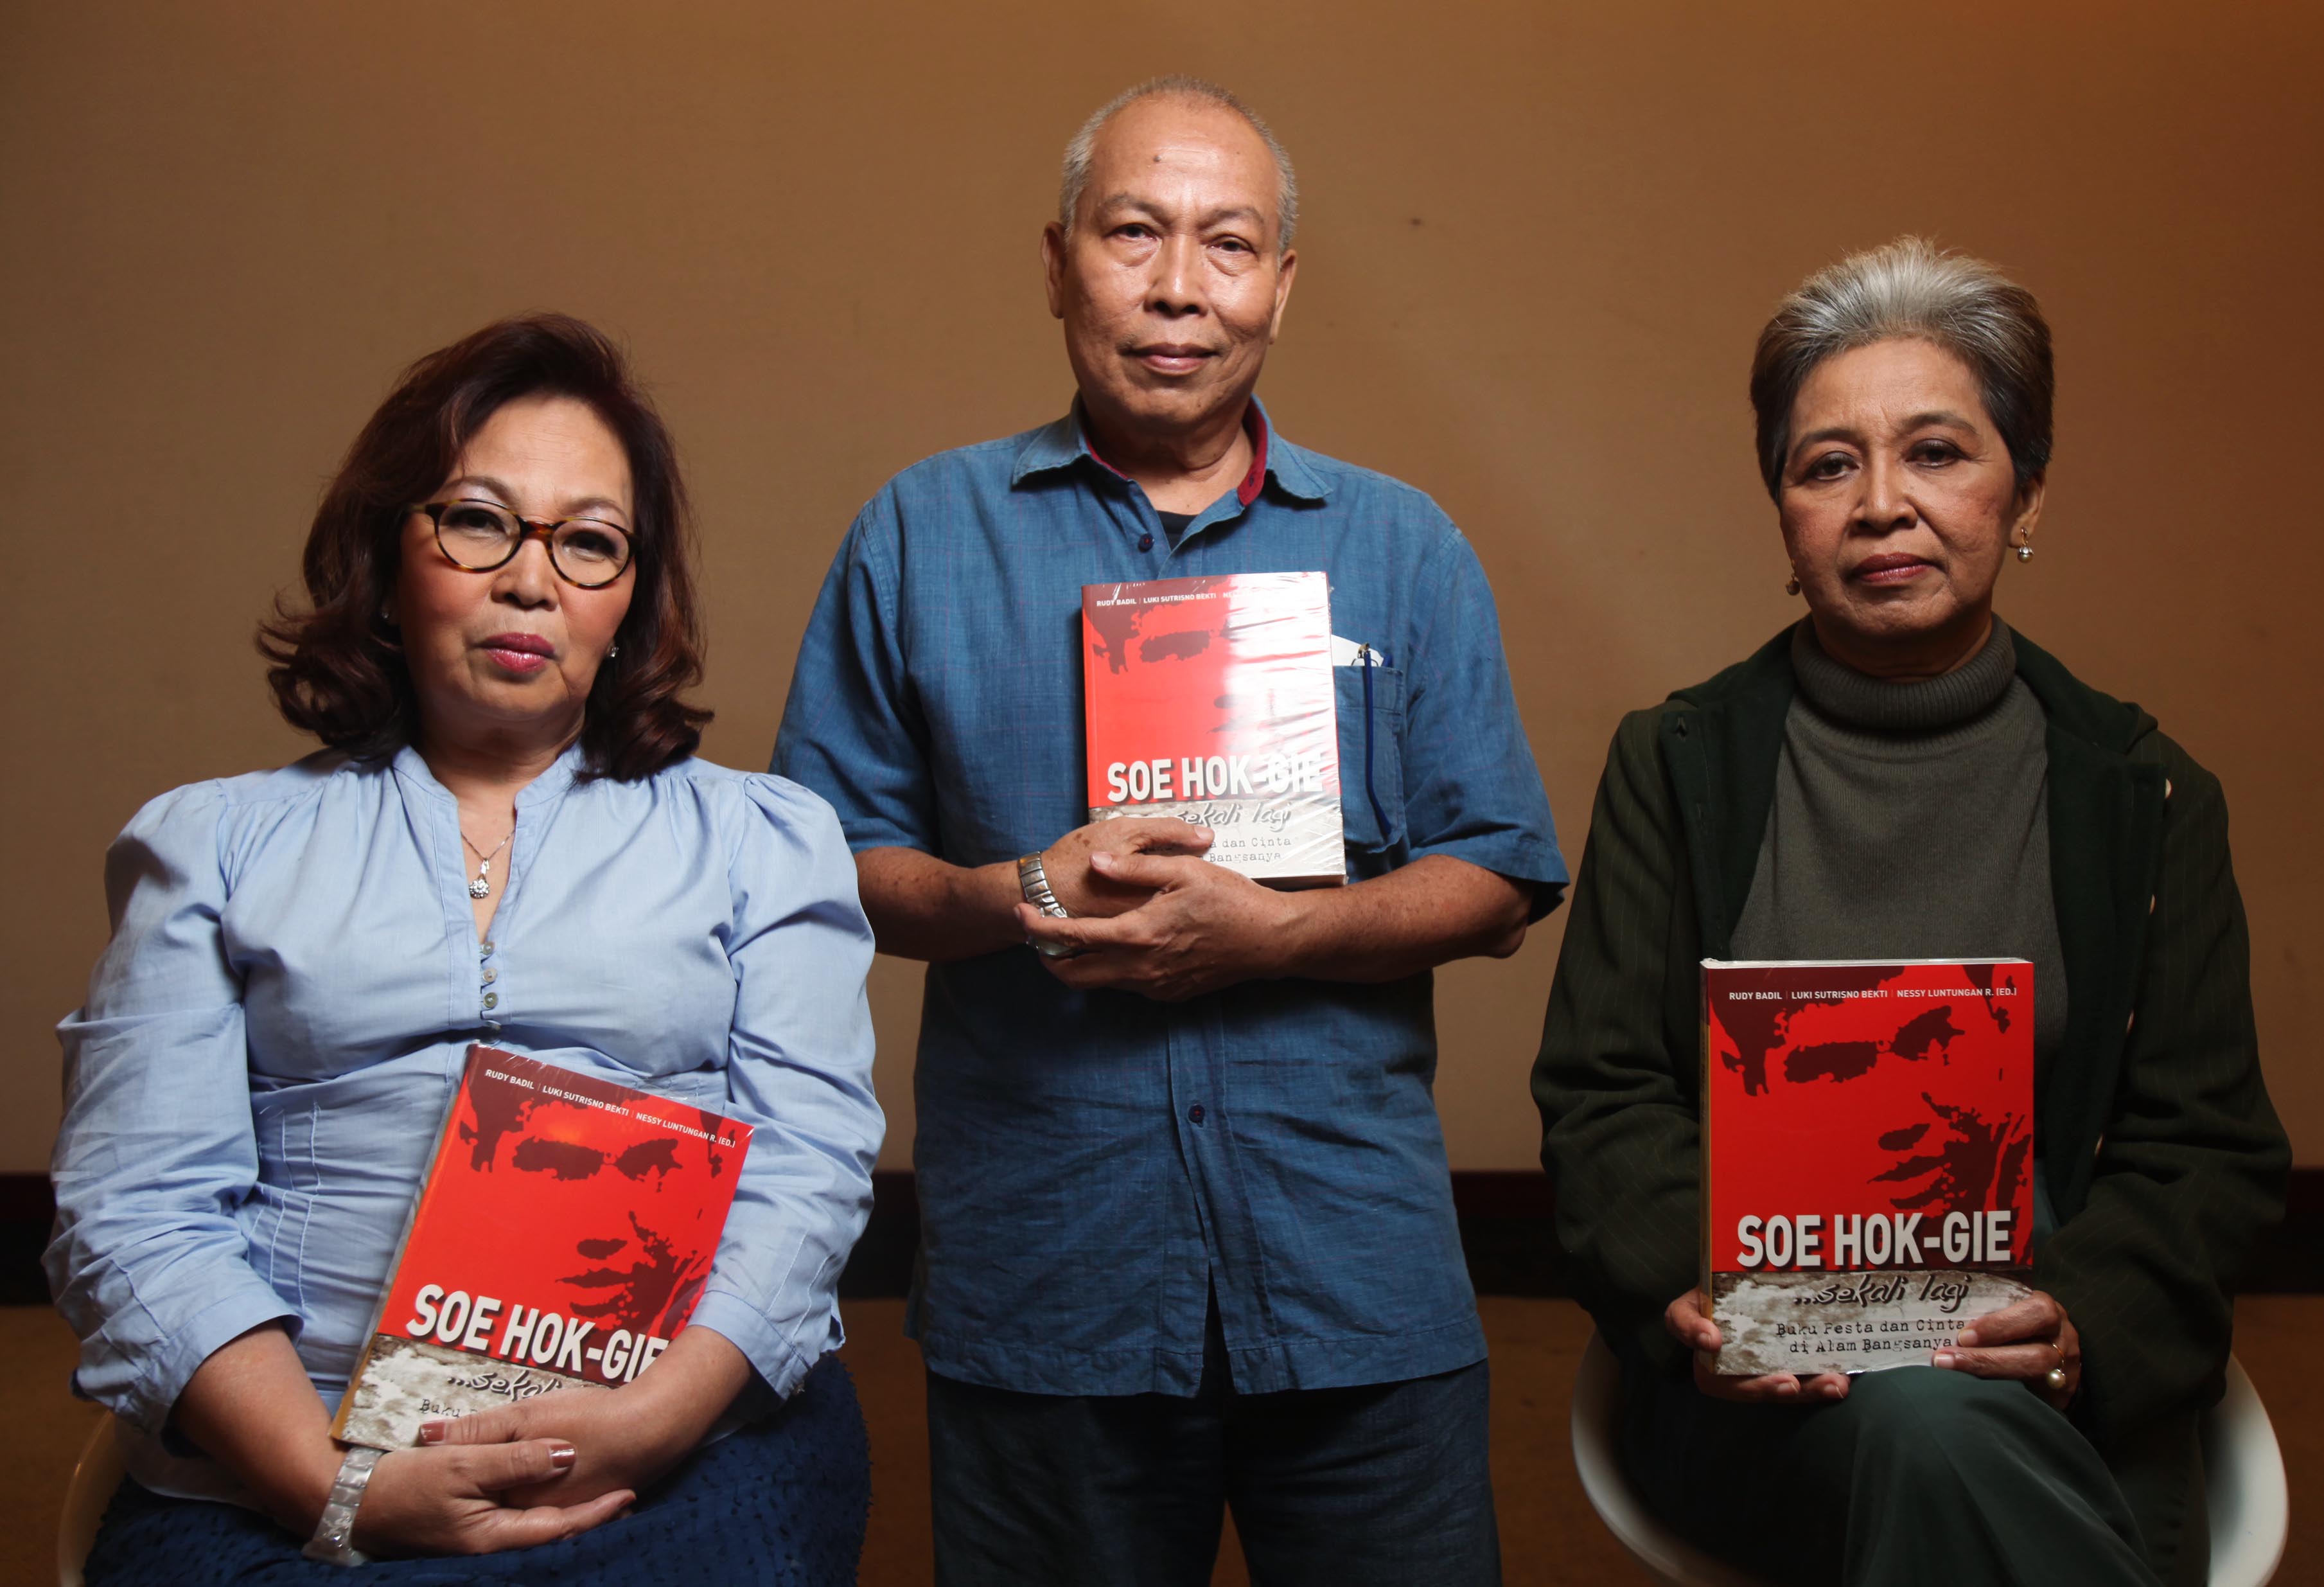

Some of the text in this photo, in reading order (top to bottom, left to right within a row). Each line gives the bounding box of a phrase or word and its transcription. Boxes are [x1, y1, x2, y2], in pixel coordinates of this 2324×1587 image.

[1116, 598, 1137, 606] BADIL
[1161, 594, 1195, 603] SUTRISNO
[1196, 592, 1217, 601] BEKTI
[1107, 751, 1324, 802] SOE HOK-GIE
[1252, 802, 1291, 833] lagi
[1222, 838, 1246, 848] dan
[1251, 837, 1291, 848] Cinta
[1209, 852, 1281, 864] Bangsanya
[1729, 992, 1754, 1000] RUDY
[1756, 991, 1783, 1000] BADIL
[1791, 991, 1813, 1000] LUKI
[1815, 990, 1859, 1000] SUTRISNO
[1861, 989, 1888, 998] BEKTI
[1897, 989, 1926, 998] NESSY
[1928, 988, 1983, 997] LUNTUNGAN
[1985, 988, 1994, 996] R.
[485, 1069, 510, 1082] RUDY
[510, 1076, 534, 1090] BADIL
[542, 1085, 562, 1097] LUKI
[563, 1091, 604, 1110] SUTRISNO
[604, 1103, 629, 1117] BEKTI
[636, 1112, 662, 1126] NESSY
[663, 1119, 709, 1140] LUNTUNGAN
[710, 1134, 717, 1142] R.
[1736, 1210, 2012, 1268] SOE HOK-GIE
[1918, 1274, 1971, 1313] lagi
[406, 1284, 669, 1383] SOE HOK-GIE
[1776, 1319, 1965, 1338] Buku Pesta dan Cinta
[1790, 1337, 1952, 1353] di Alam Bangsanya
[419, 1398, 461, 1418] Buku
